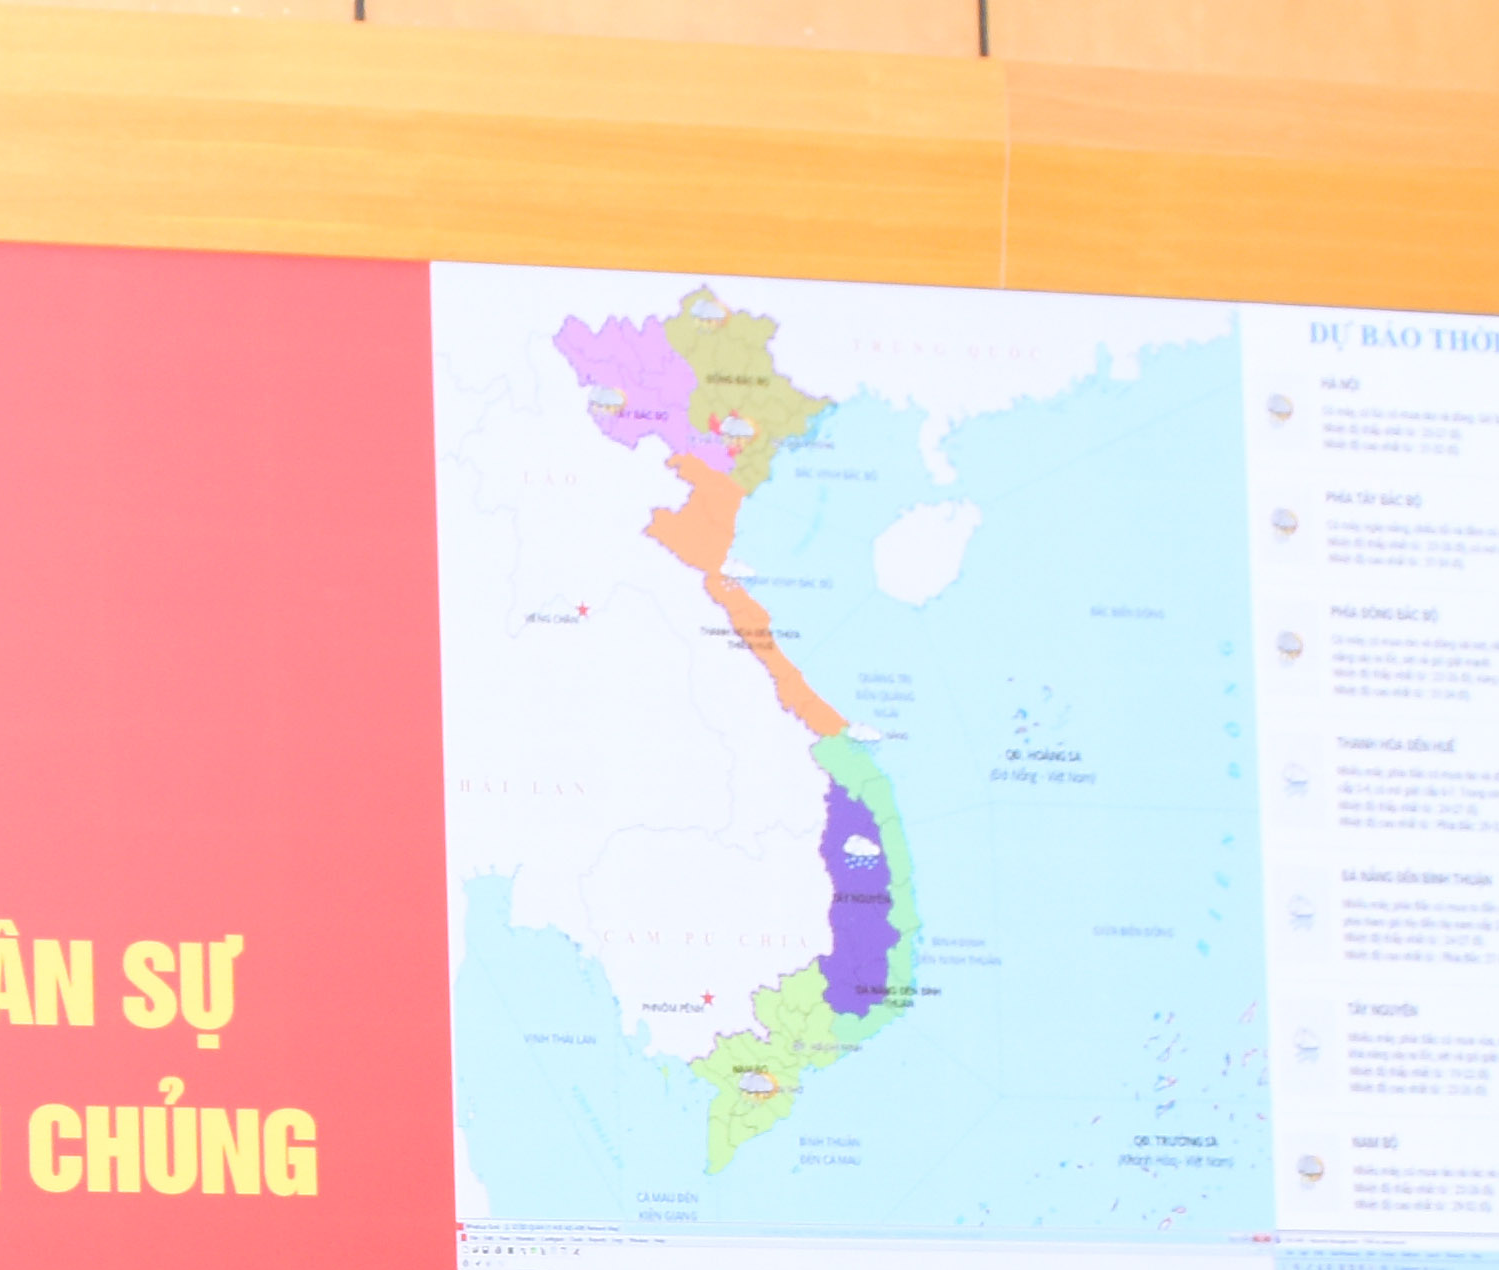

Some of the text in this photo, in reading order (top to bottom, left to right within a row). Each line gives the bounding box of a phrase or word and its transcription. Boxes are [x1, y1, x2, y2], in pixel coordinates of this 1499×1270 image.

[1309, 321, 1352, 351] DỰ
[1362, 324, 1423, 348] BÁO
[123, 935, 243, 1049] SỰ
[29, 1076, 317, 1196] CHỦNG
